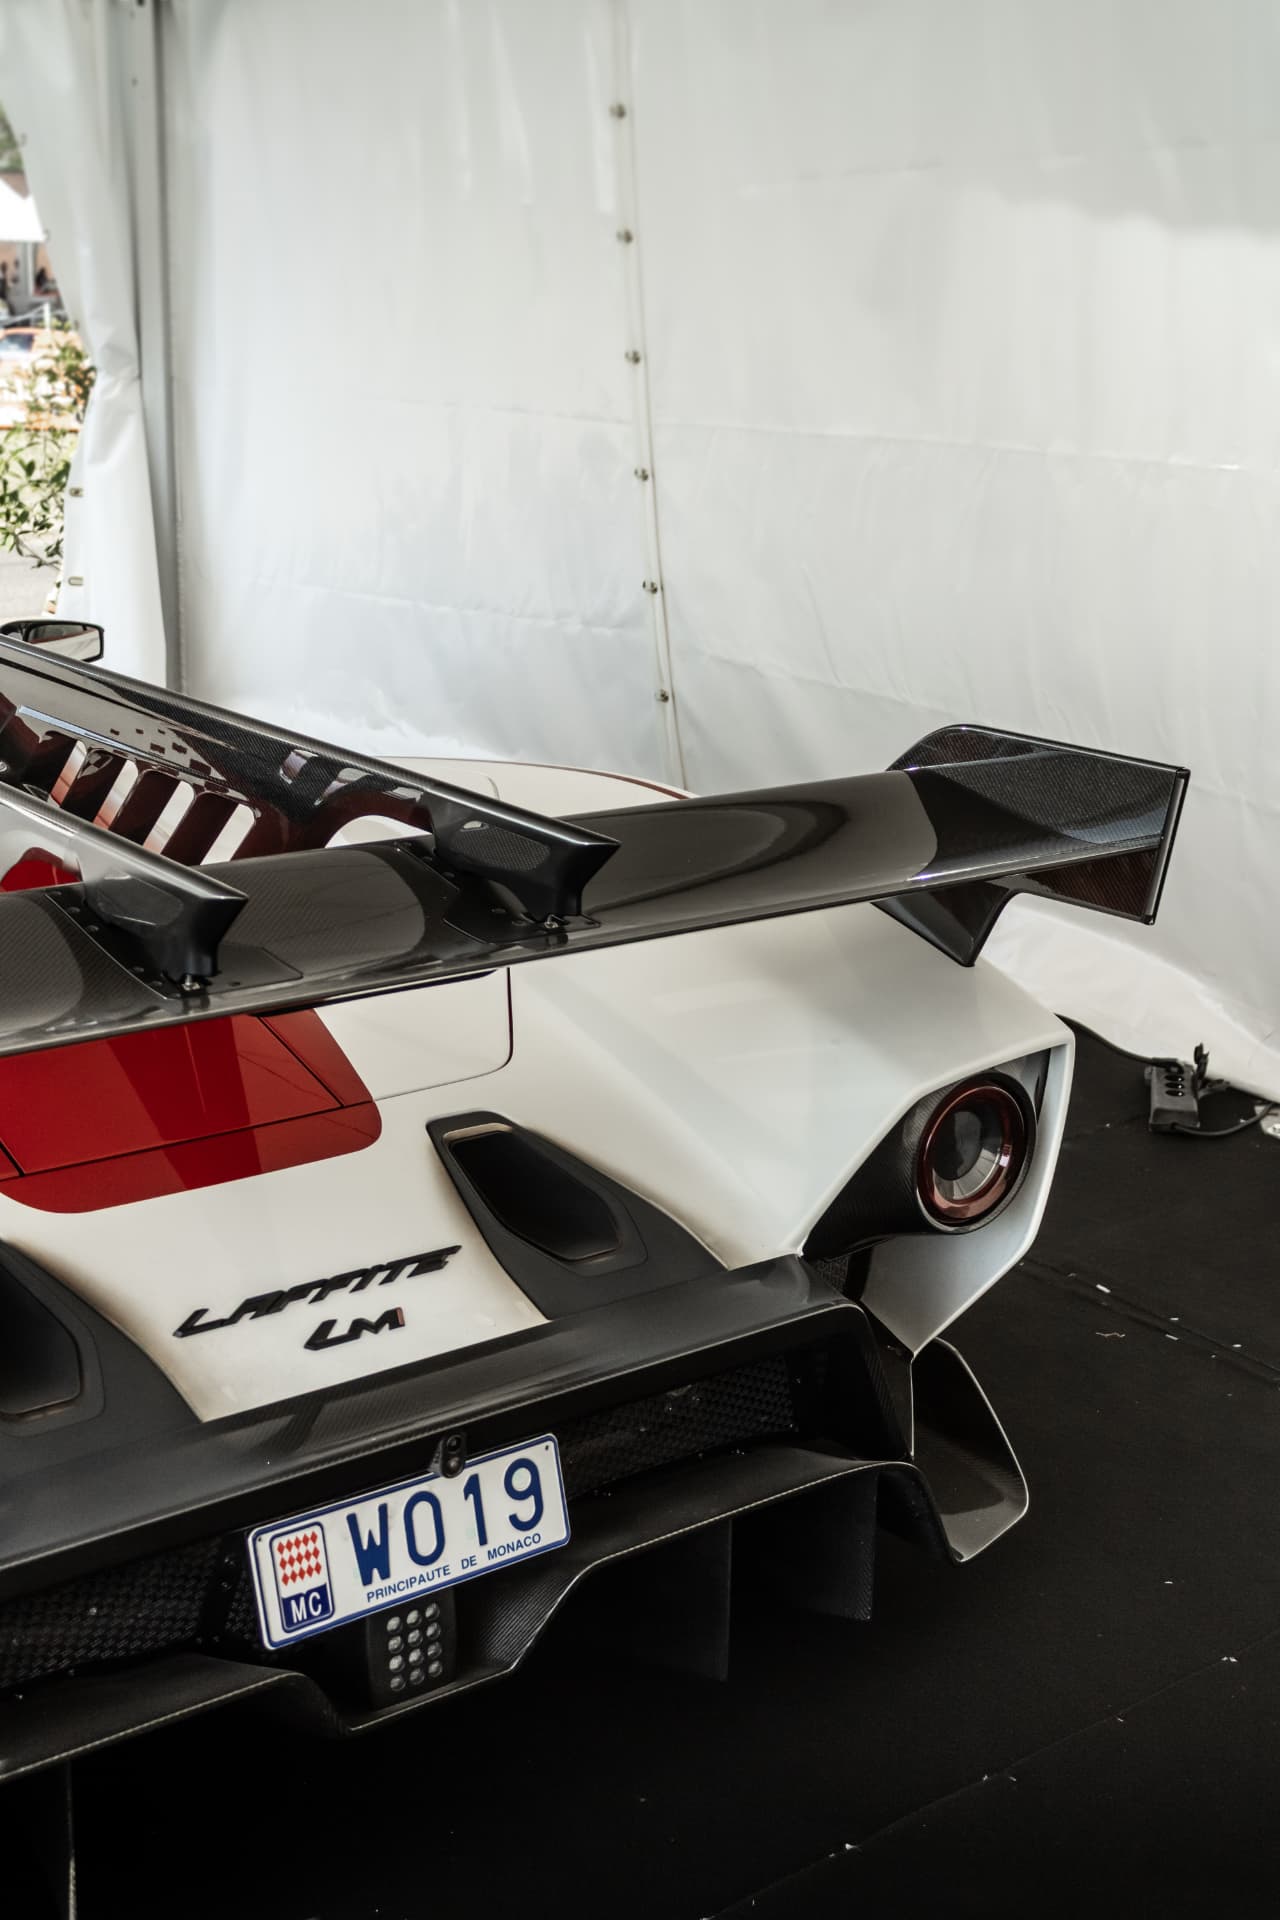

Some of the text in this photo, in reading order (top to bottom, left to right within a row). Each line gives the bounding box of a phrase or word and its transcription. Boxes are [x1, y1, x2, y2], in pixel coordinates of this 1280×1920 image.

[303, 1307, 405, 1351] LM
[366, 1532, 542, 1603] PRINCIPAUTE DE MONACO
[290, 1591, 323, 1624] MC
